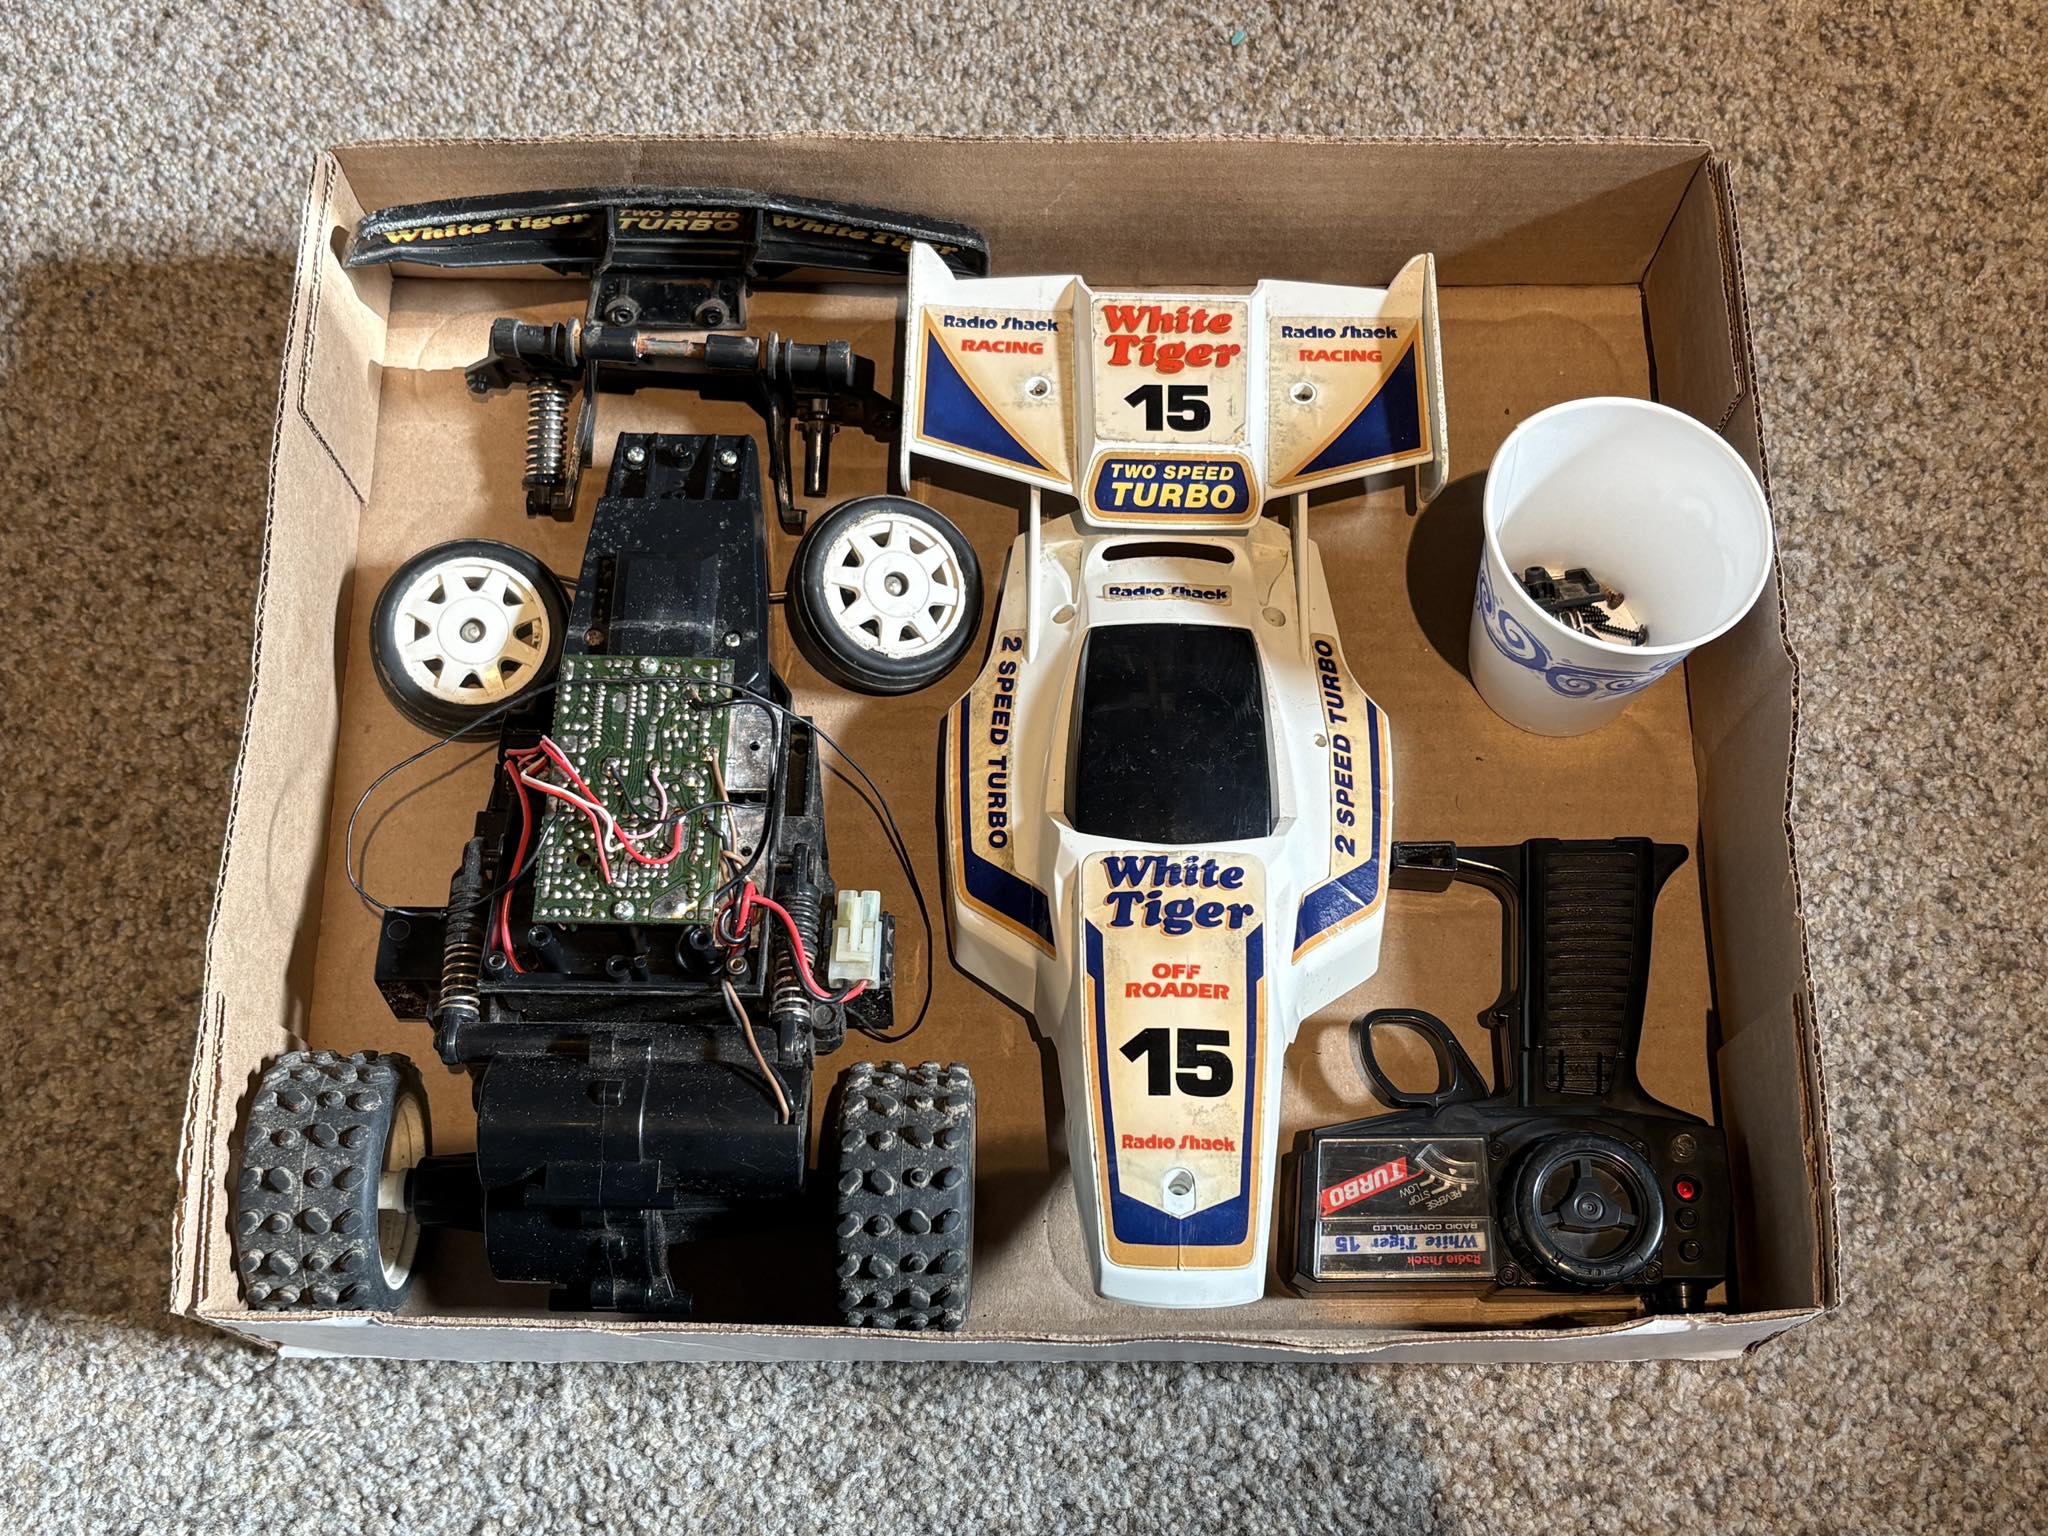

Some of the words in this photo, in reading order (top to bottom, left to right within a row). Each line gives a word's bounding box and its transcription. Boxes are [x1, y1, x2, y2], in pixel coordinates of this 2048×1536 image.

[618, 209, 665, 217] TWO
[669, 210, 740, 219] SPEED
[384, 222, 492, 244] White
[495, 213, 591, 231] Tiger
[618, 217, 739, 231] TURBO
[772, 214, 866, 241] White
[942, 314, 998, 332] Radio
[1001, 315, 1059, 333] Shack
[1099, 305, 1233, 335] White
[1281, 325, 1336, 339] Radio
[1339, 325, 1398, 340] Shack
[961, 338, 1044, 355] RACING
[1105, 333, 1241, 375] Tiger
[1299, 348, 1382, 363] RACING
[1123, 384, 1211, 432] 15
[1111, 463, 1157, 479] TWO
[1163, 465, 1235, 481] SPEED
[1111, 481, 1236, 509] TURBO
[1109, 586, 1165, 597] Radio
[1001, 636, 1022, 652] 2
[1315, 640, 1348, 724] TURBO
[990, 660, 1017, 746] SPEED
[1332, 733, 1356, 827] SPEED
[988, 756, 1008, 849] TURBO
[1334, 835, 1355, 857] 2
[1101, 855, 1244, 890] White
[1105, 890, 1254, 936] Tiger
[1152, 963, 1201, 979] OFF
[1125, 982, 1230, 1000] ROADER
[1119, 1027, 1233, 1098] 15
[1122, 1133, 1176, 1150] Radio
[1178, 1133, 1236, 1151] Shack
[1329, 1162, 1405, 1208] TURBO
[1399, 1183, 1421, 1198] LOW
[1408, 1190, 1431, 1206] STOP
[1427, 1190, 1462, 1211] REVERSE
[1373, 1223, 1442, 1231] CONTROLLED
[1335, 1236, 1361, 1252] 15
[1371, 1233, 1418, 1250] Tiger
[1425, 1234, 1478, 1249] White
[1408, 1256, 1443, 1265] Shack
[1447, 1254, 1481, 1264] Radio
